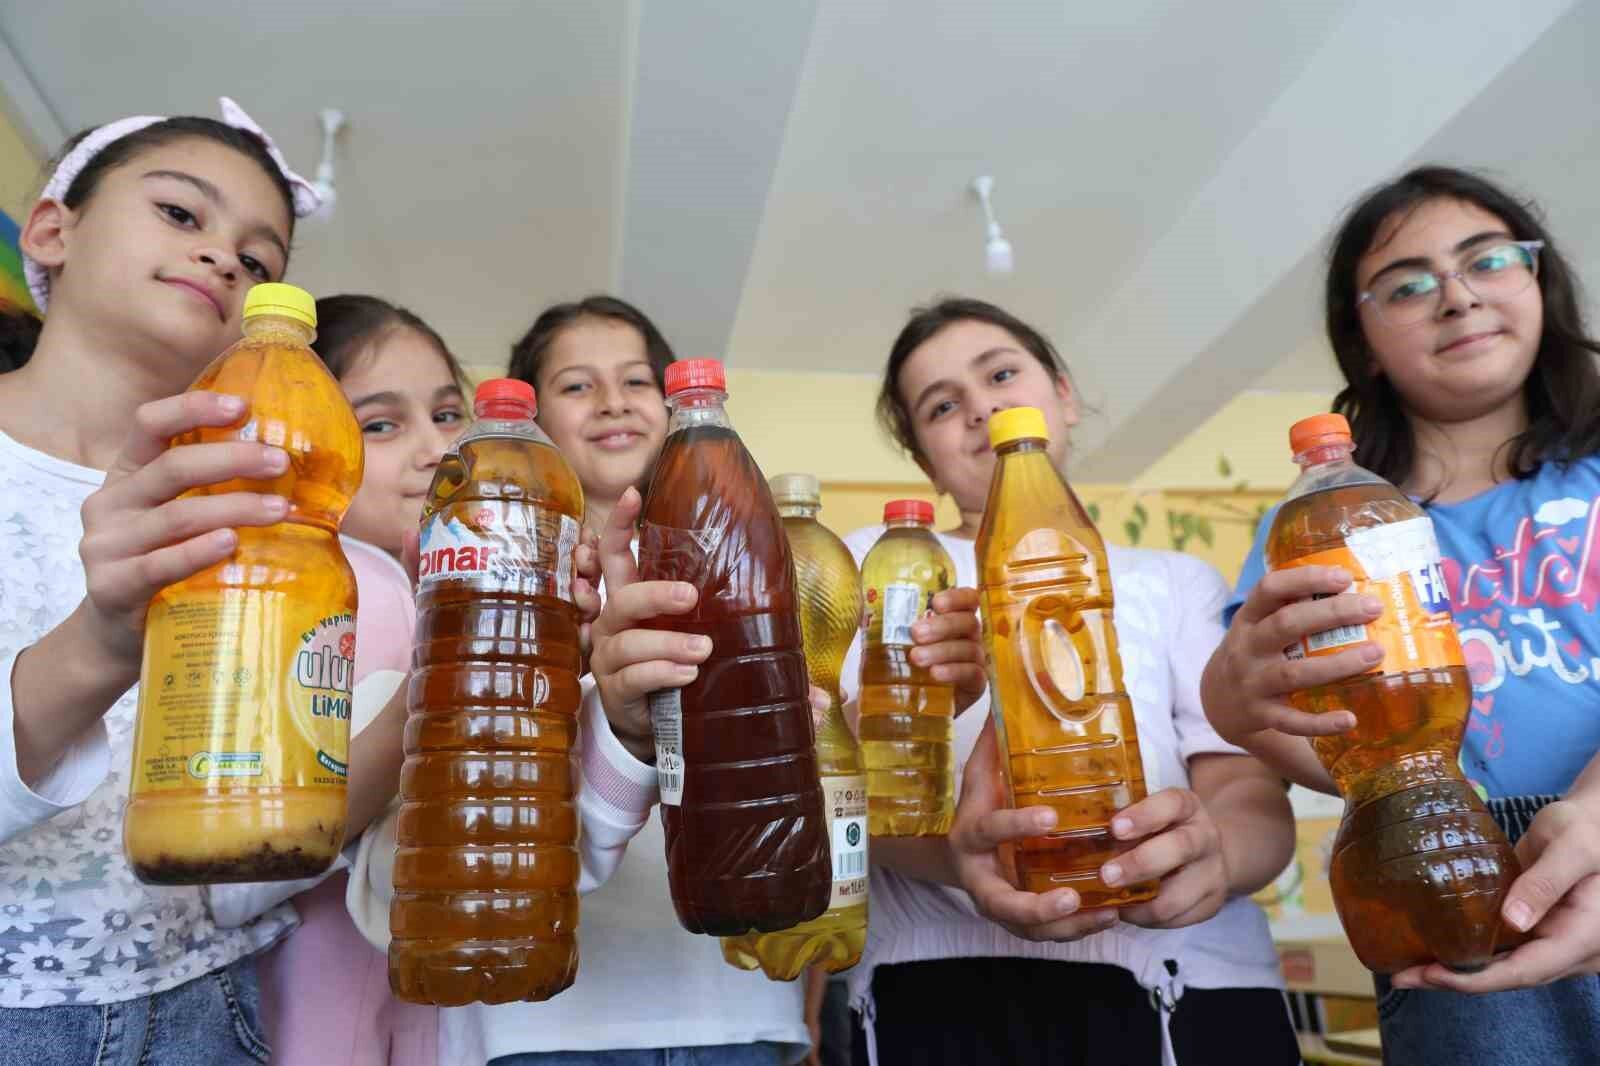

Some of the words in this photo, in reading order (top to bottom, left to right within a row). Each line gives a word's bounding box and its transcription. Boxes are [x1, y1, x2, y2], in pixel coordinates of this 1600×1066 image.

[1409, 562, 1450, 604] FA
[320, 613, 354, 628] Yapım
[298, 644, 353, 694] ulu
[1459, 608, 1589, 692] Out
